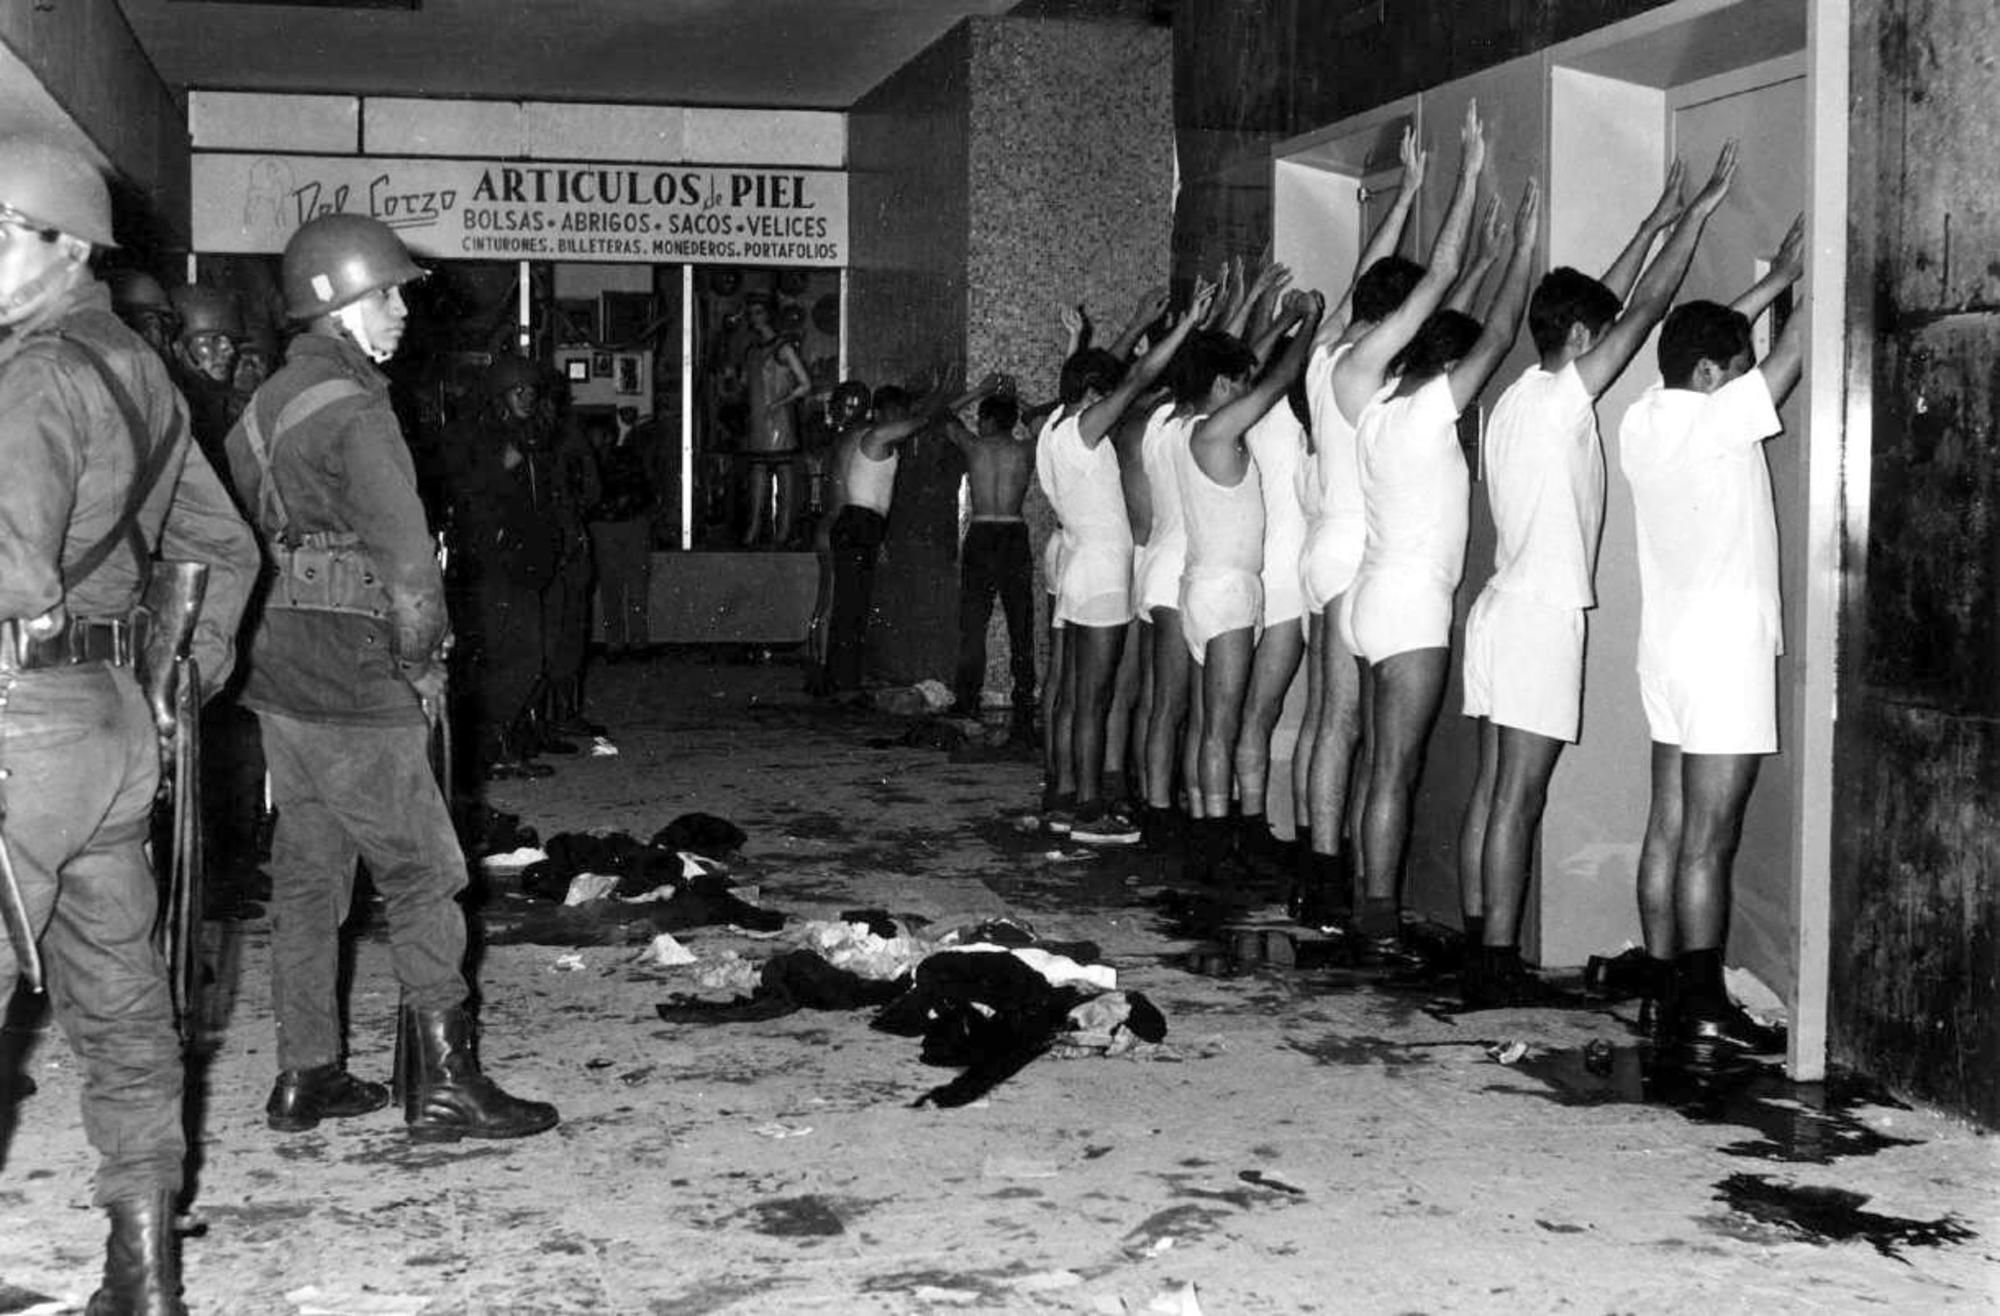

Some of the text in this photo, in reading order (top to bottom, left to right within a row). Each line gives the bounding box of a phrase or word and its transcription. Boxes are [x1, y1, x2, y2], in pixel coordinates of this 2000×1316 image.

[369, 174, 456, 217] Corzo
[472, 168, 815, 210] ARTICULOS de PIEL
[463, 208, 827, 238] BOLSAS ABRIGOS SACOS VELICES
[744, 242, 838, 260] PORTAFOLIOS
